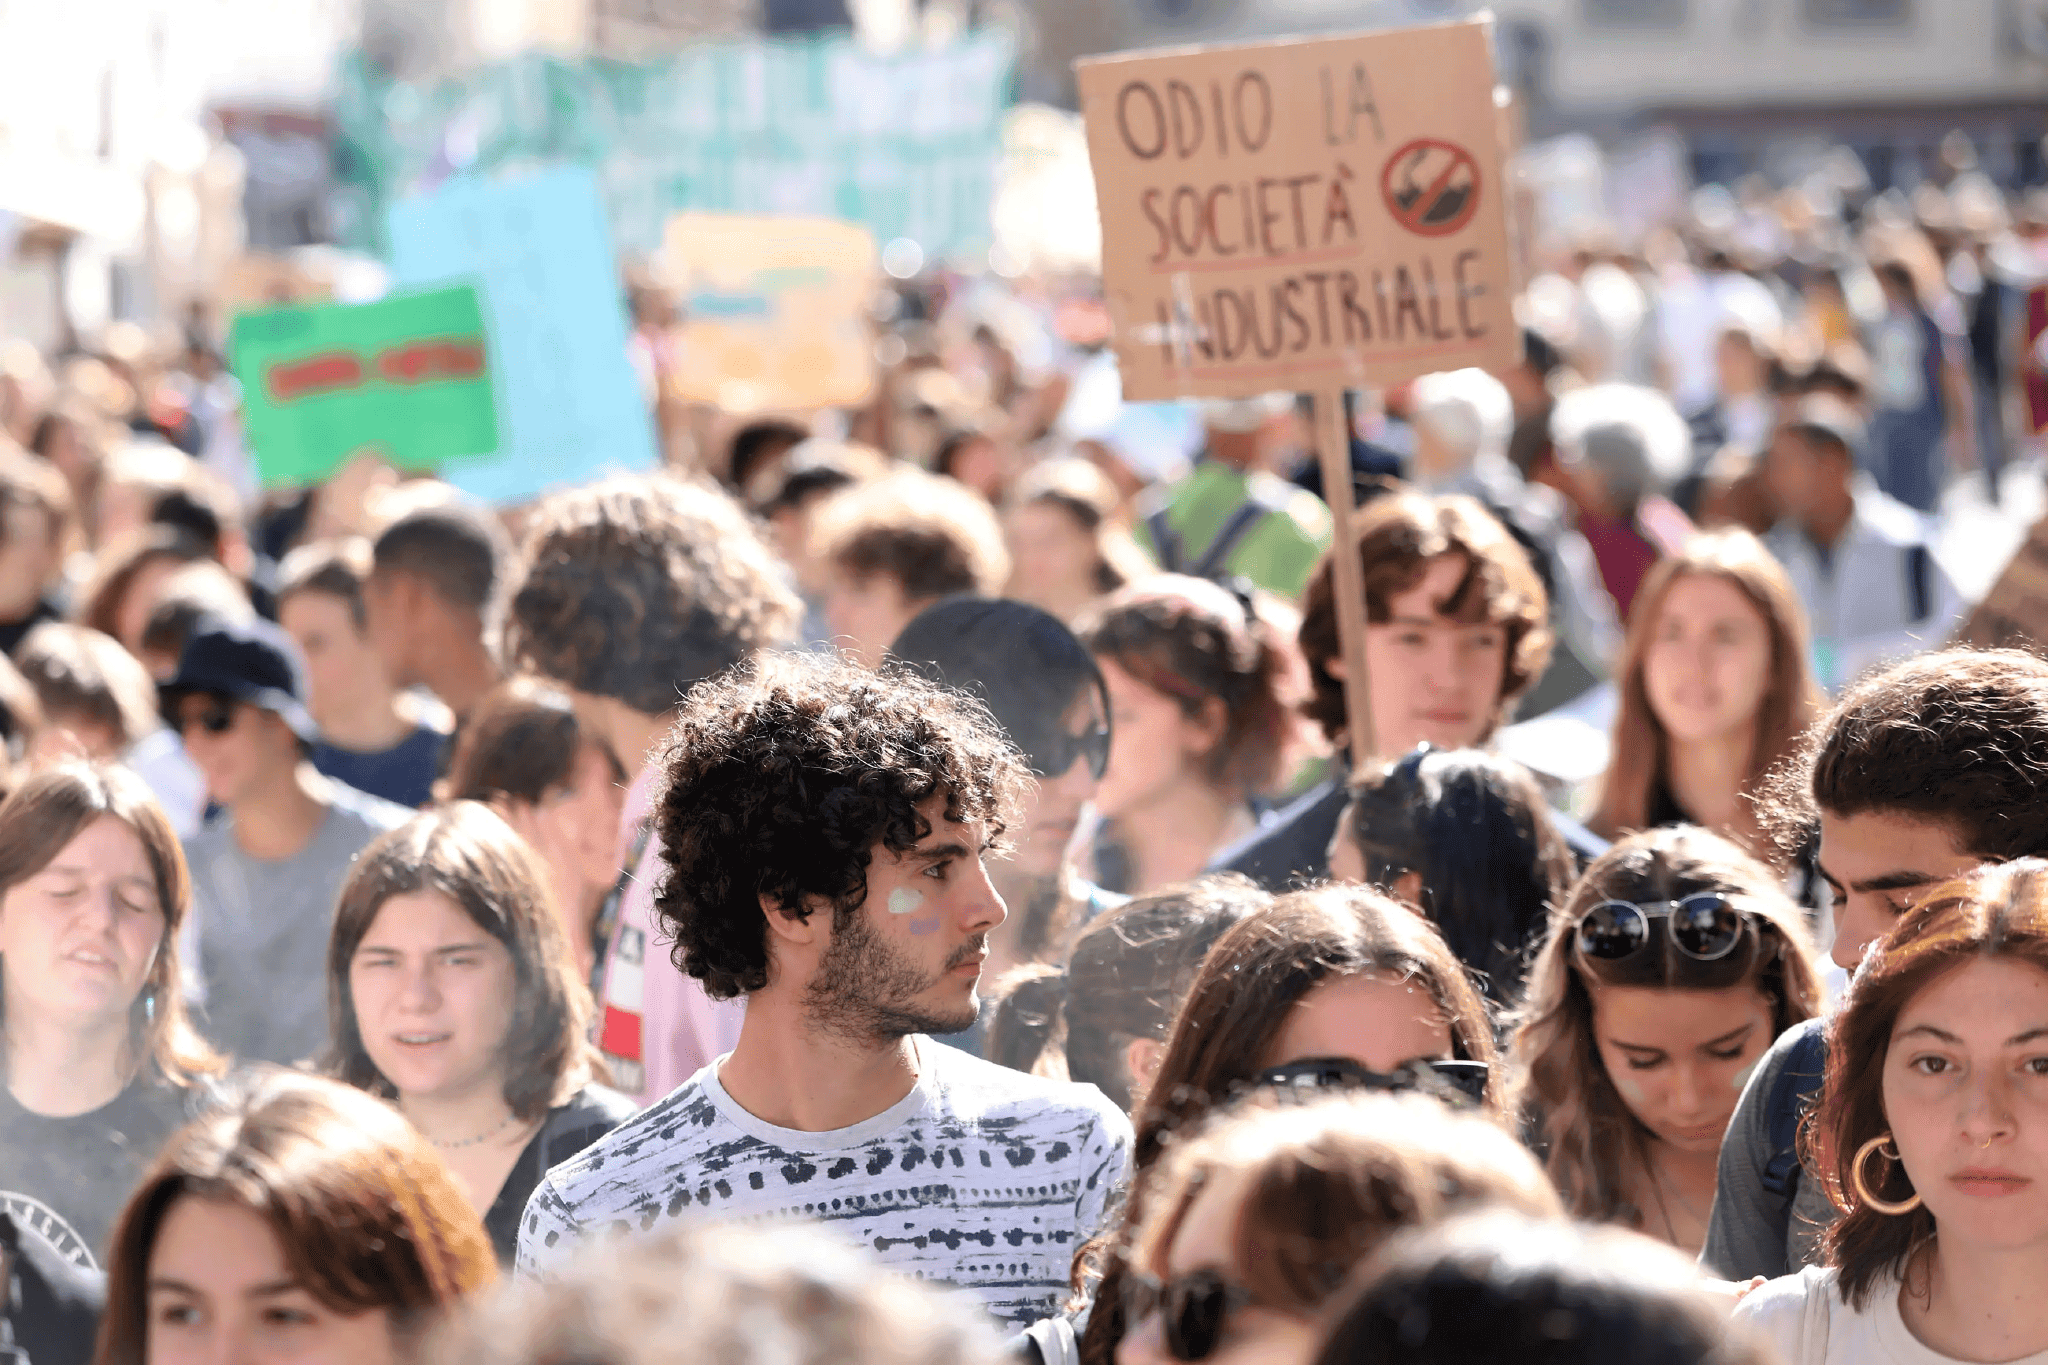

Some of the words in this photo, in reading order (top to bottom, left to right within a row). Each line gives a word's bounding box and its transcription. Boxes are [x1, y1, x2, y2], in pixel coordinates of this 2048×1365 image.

[1116, 70, 1272, 160] ODIO
[1320, 61, 1384, 146] LA
[1141, 162, 1357, 263] SOCIETÀ
[1155, 249, 1488, 366] INDUSTRIALE
